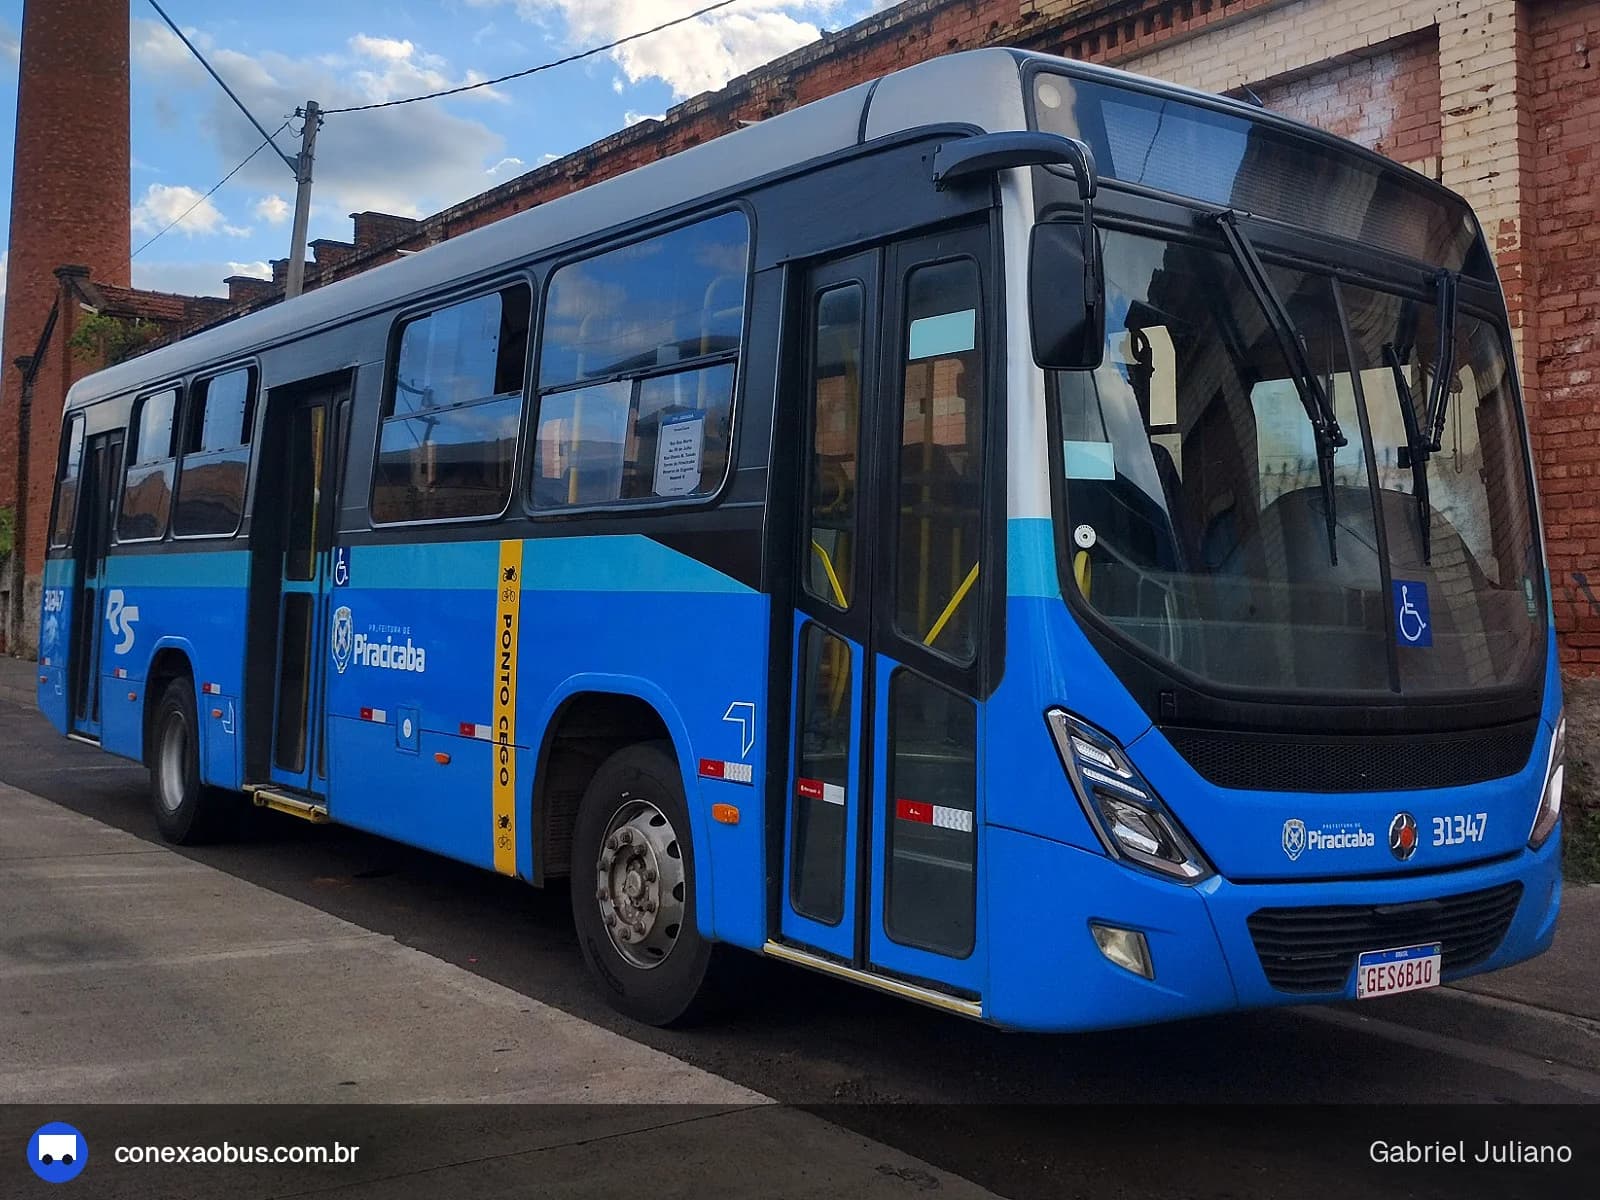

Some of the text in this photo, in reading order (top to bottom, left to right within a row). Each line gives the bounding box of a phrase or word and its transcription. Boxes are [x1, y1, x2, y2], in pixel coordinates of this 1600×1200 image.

[106, 589, 139, 655] RS
[353, 633, 425, 673] Piracicaba
[499, 614, 513, 786] PONTO CEGO
[1308, 828, 1375, 850] Piracicaba
[1432, 812, 1488, 846] 31347
[1367, 959, 1432, 993] GES6B10
